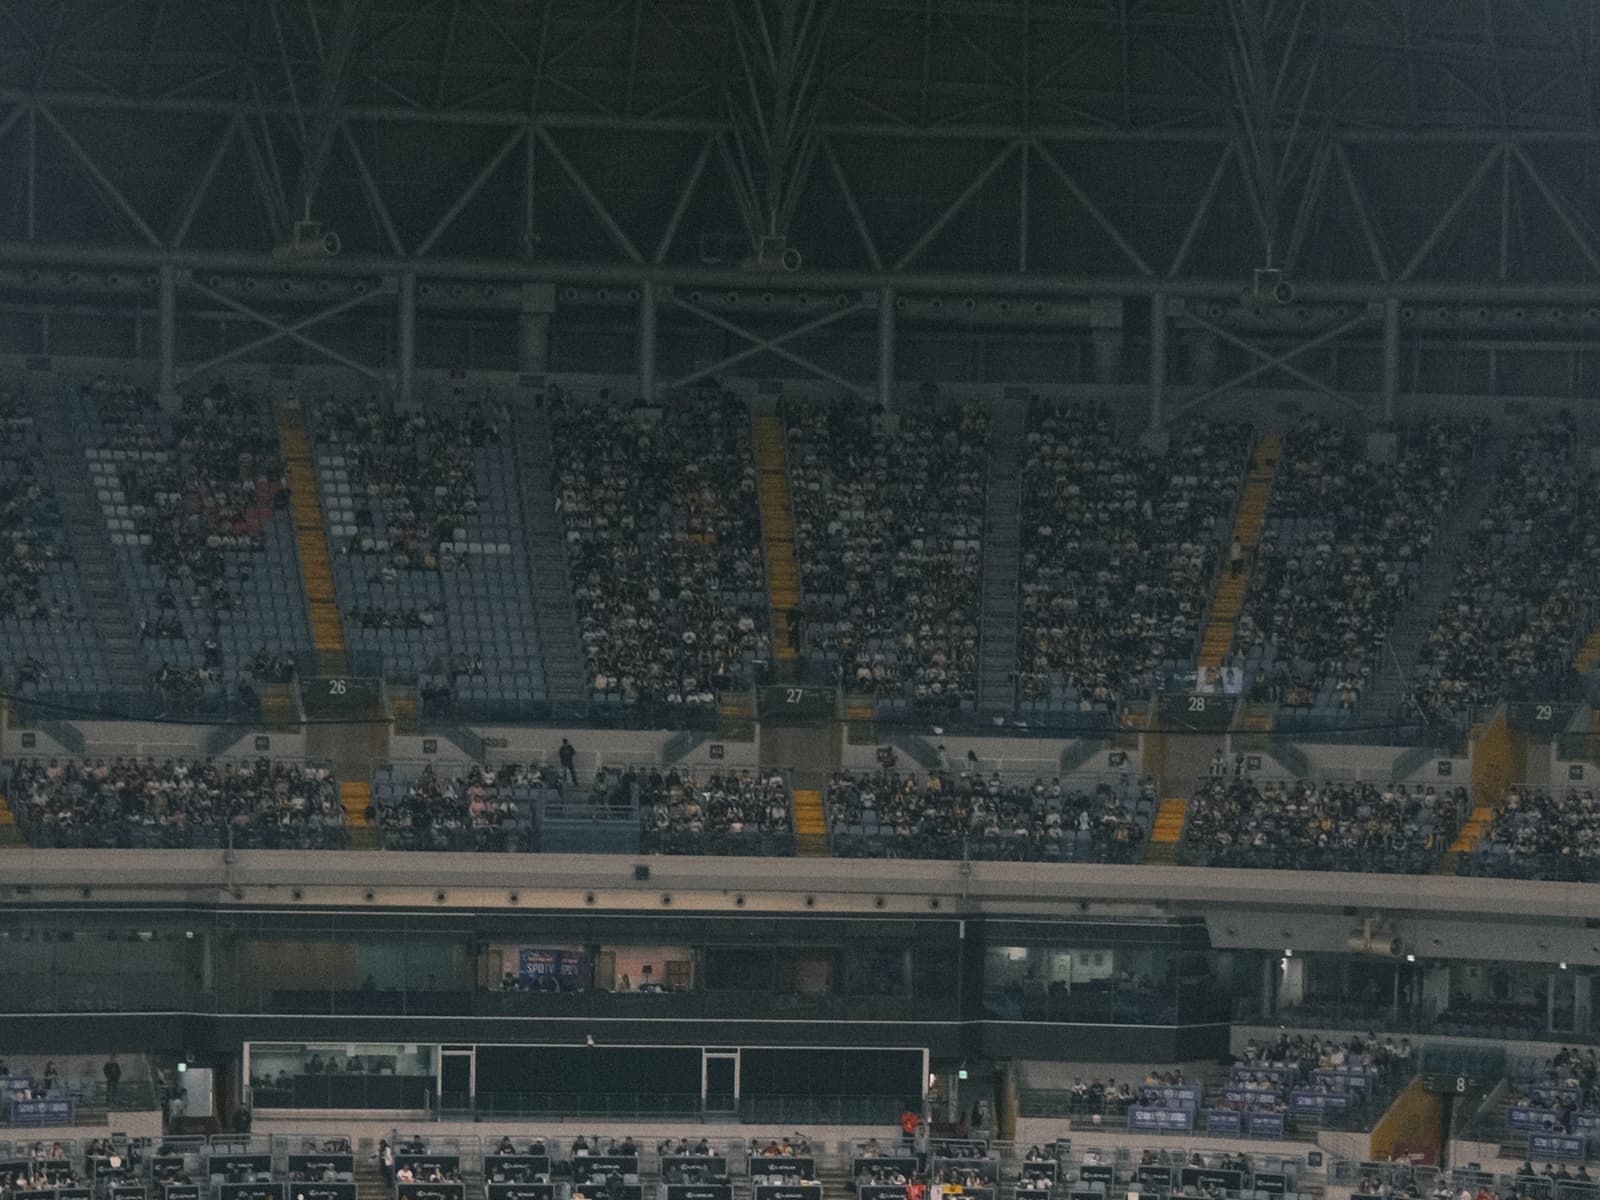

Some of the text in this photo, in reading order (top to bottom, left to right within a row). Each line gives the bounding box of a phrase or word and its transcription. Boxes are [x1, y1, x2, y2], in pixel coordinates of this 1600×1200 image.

[329, 680, 346, 694] 26
[786, 688, 803, 704] 27
[1188, 697, 1205, 711] 28
[1536, 705, 1552, 720] 29
[1456, 1077, 1465, 1092] 8
